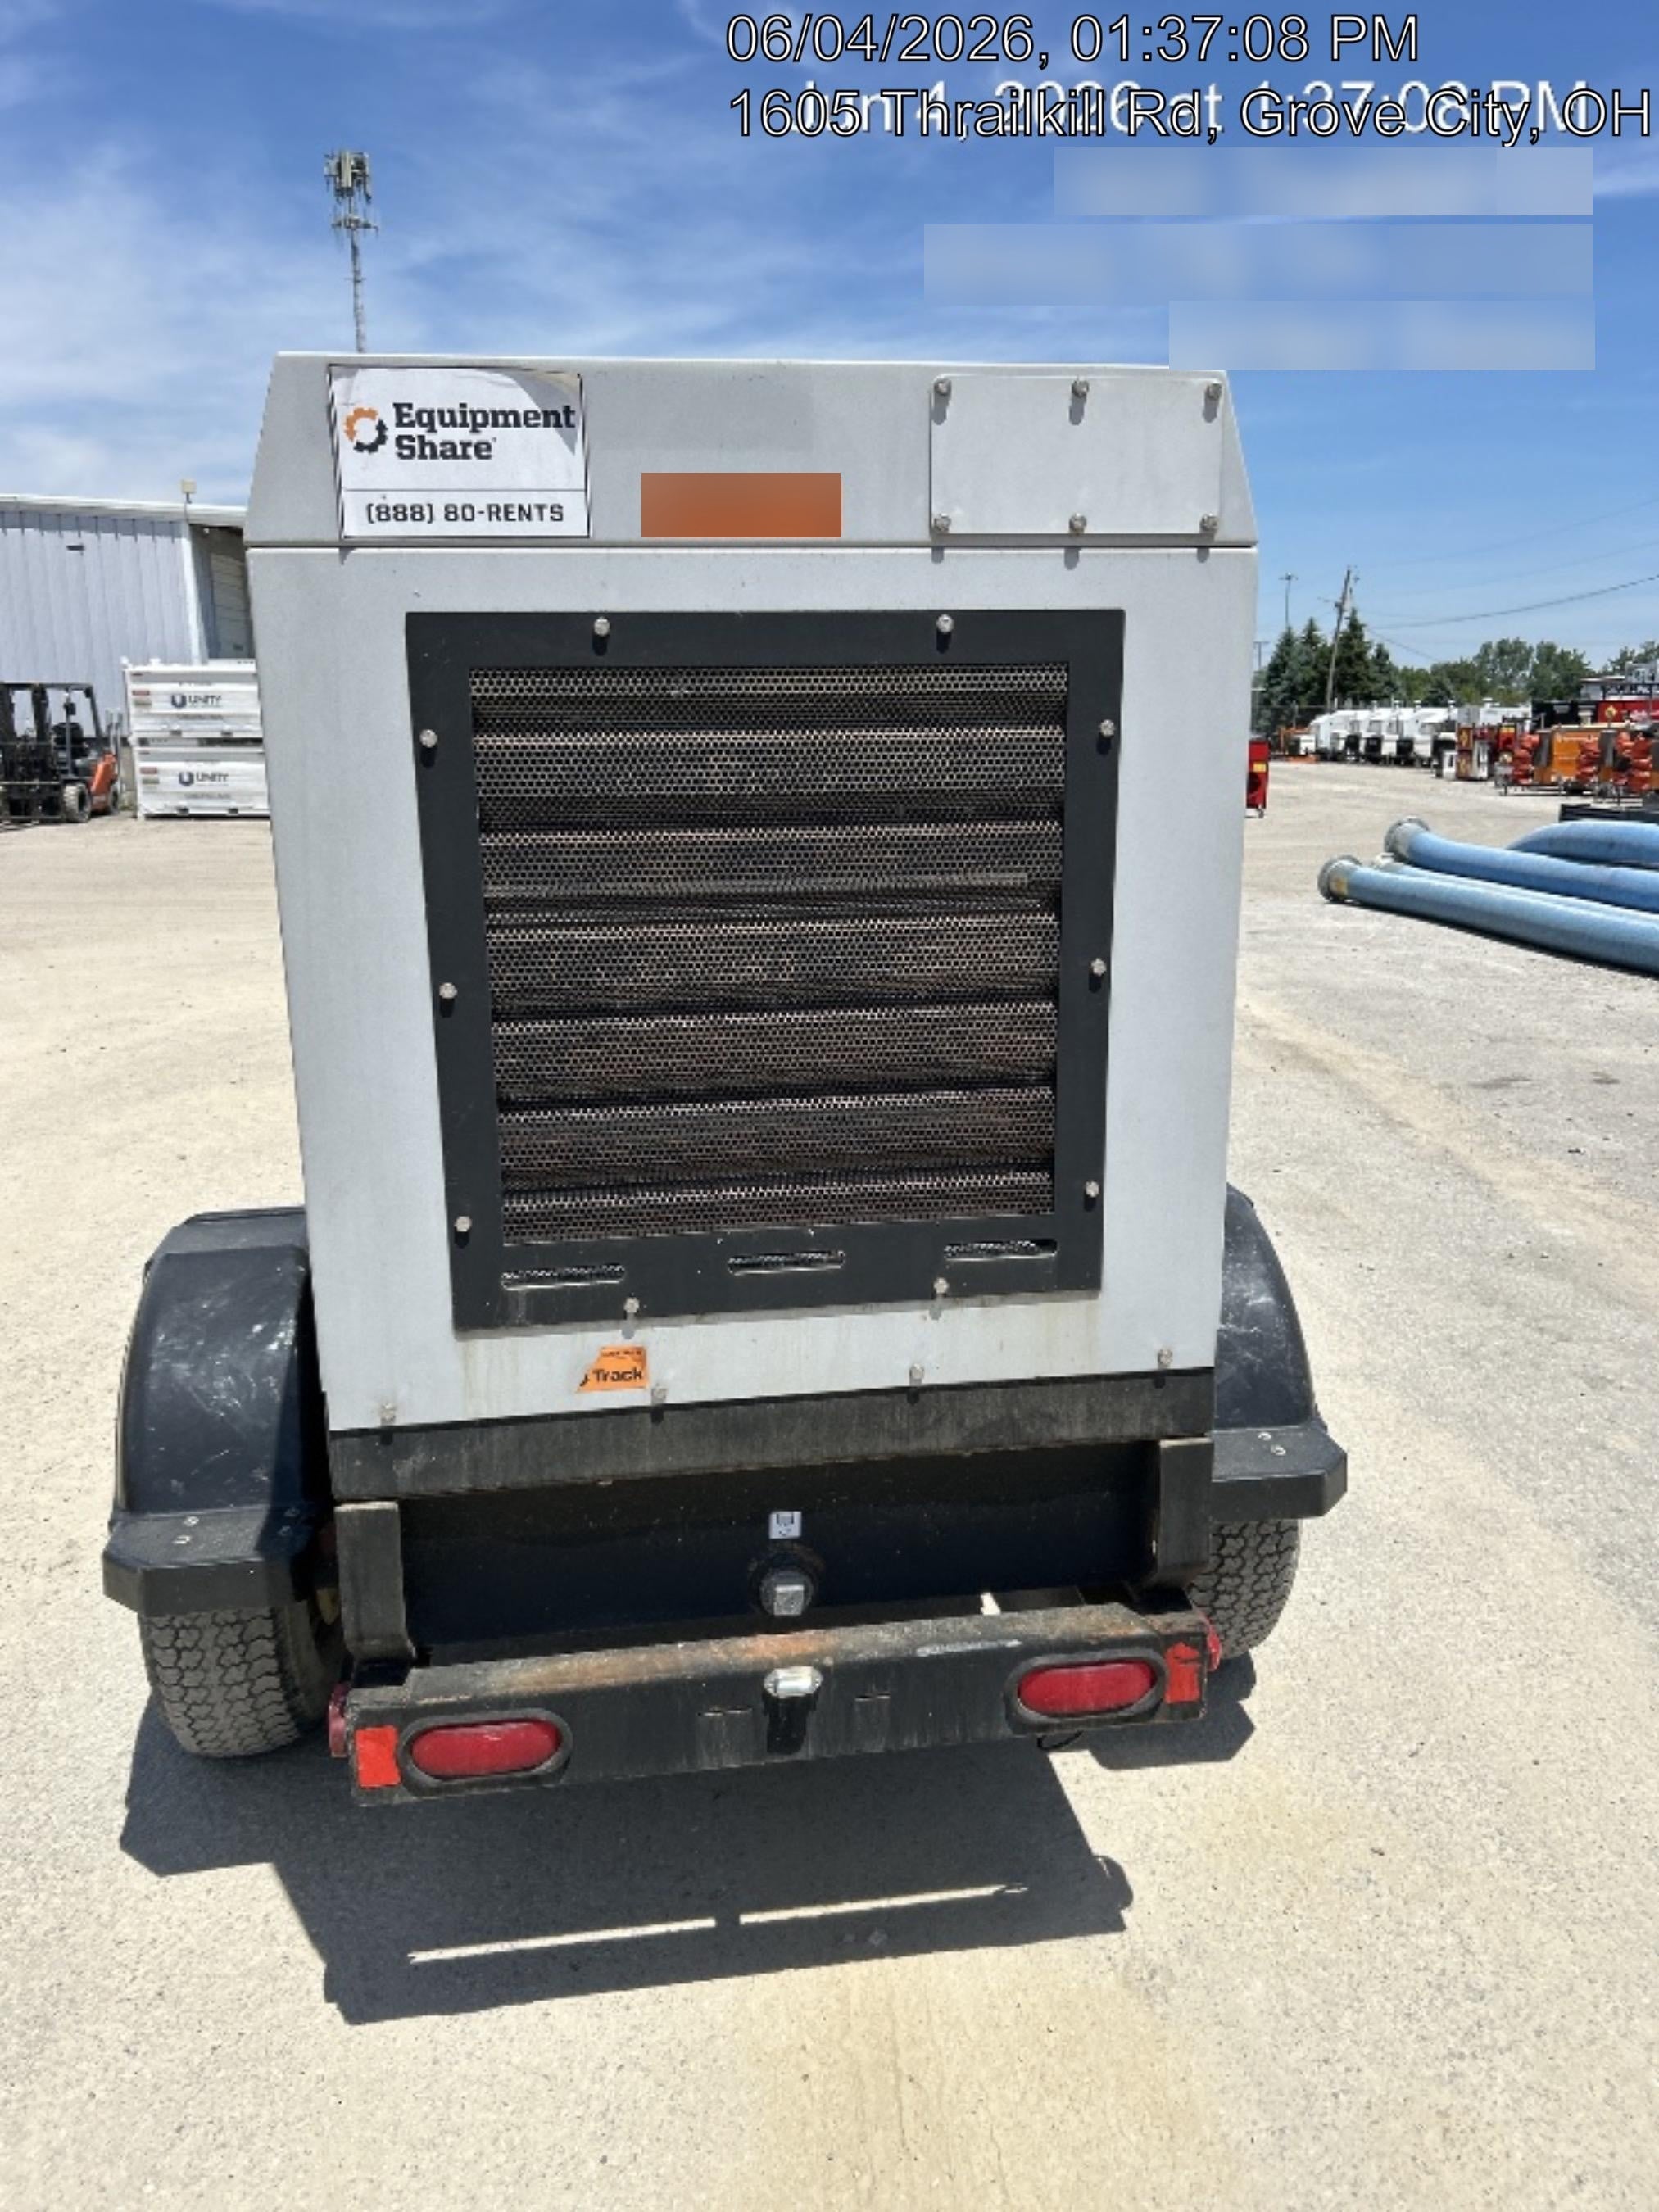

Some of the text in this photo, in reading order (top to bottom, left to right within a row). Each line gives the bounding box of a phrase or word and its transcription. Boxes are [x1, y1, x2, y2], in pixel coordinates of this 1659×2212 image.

[392, 402, 576, 433] Equipment
[395, 434, 493, 460] Share
[366, 503, 564, 524] (888) 80-RENTS
[592, 1367, 642, 1382] Track
